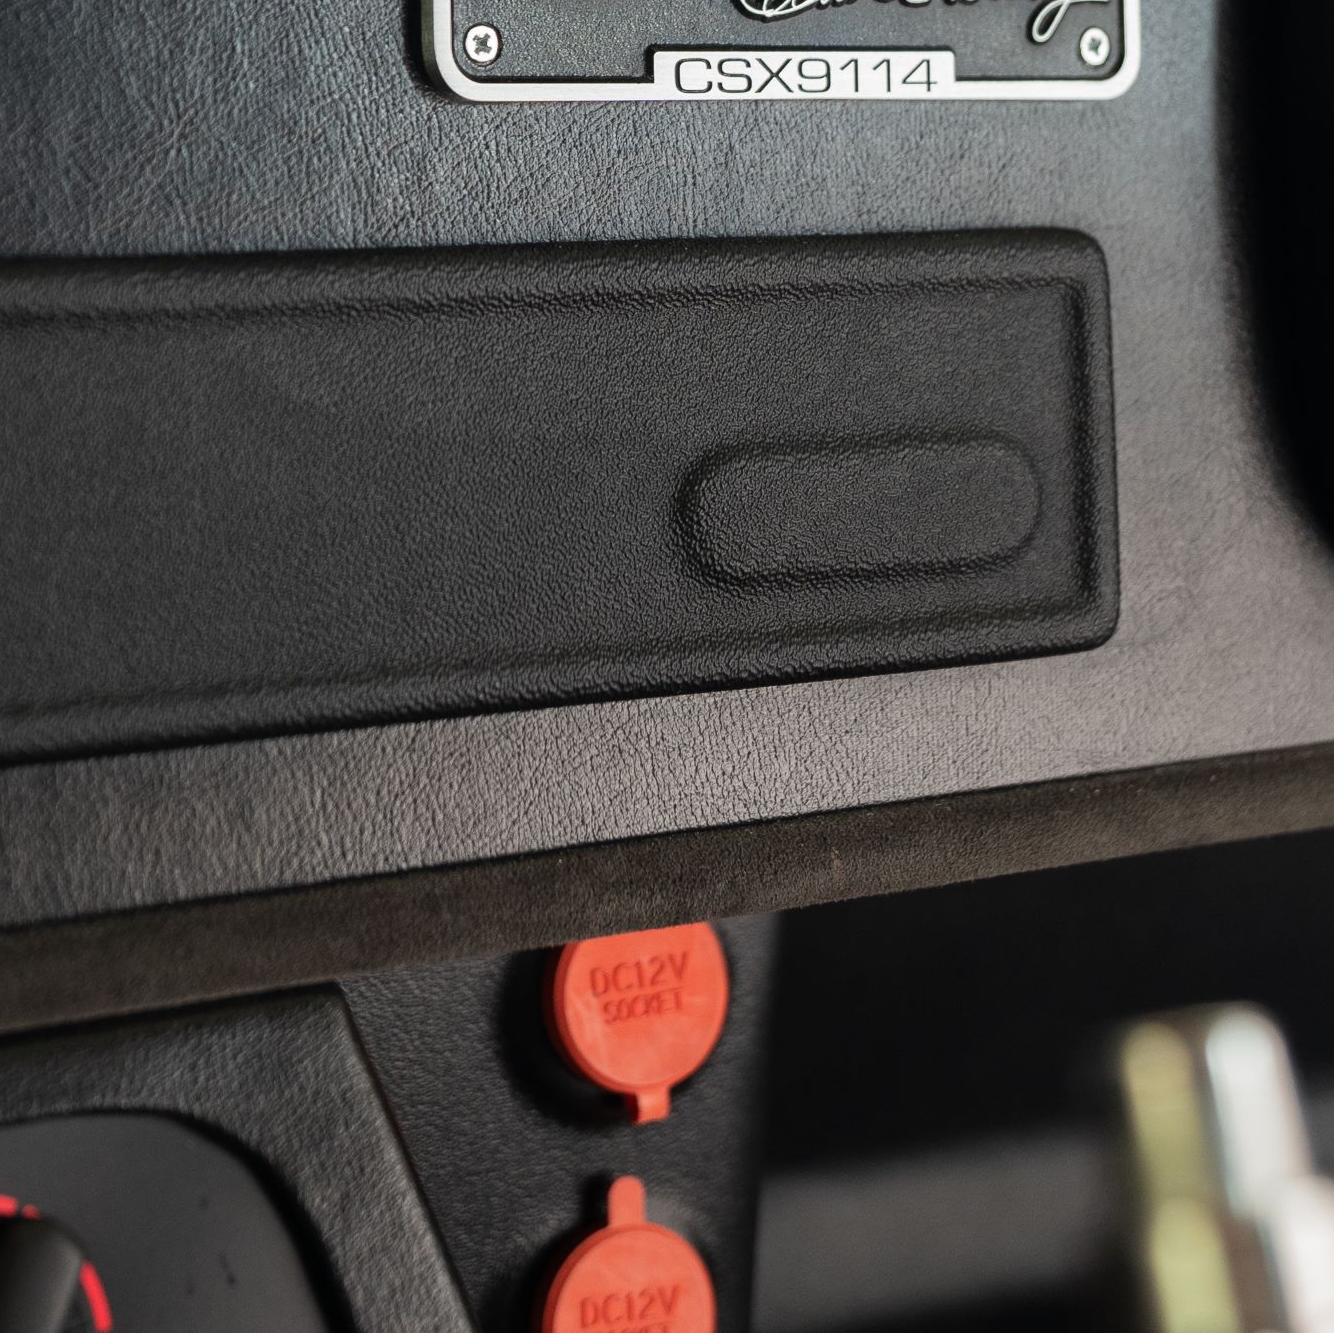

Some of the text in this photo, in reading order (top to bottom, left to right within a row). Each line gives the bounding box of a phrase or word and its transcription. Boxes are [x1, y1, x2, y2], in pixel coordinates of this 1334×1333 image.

[673, 57, 938, 95] CSX9114
[589, 951, 690, 999] DC12V
[603, 987, 684, 1025] SOCKET
[580, 1285, 681, 1328] DC12V
